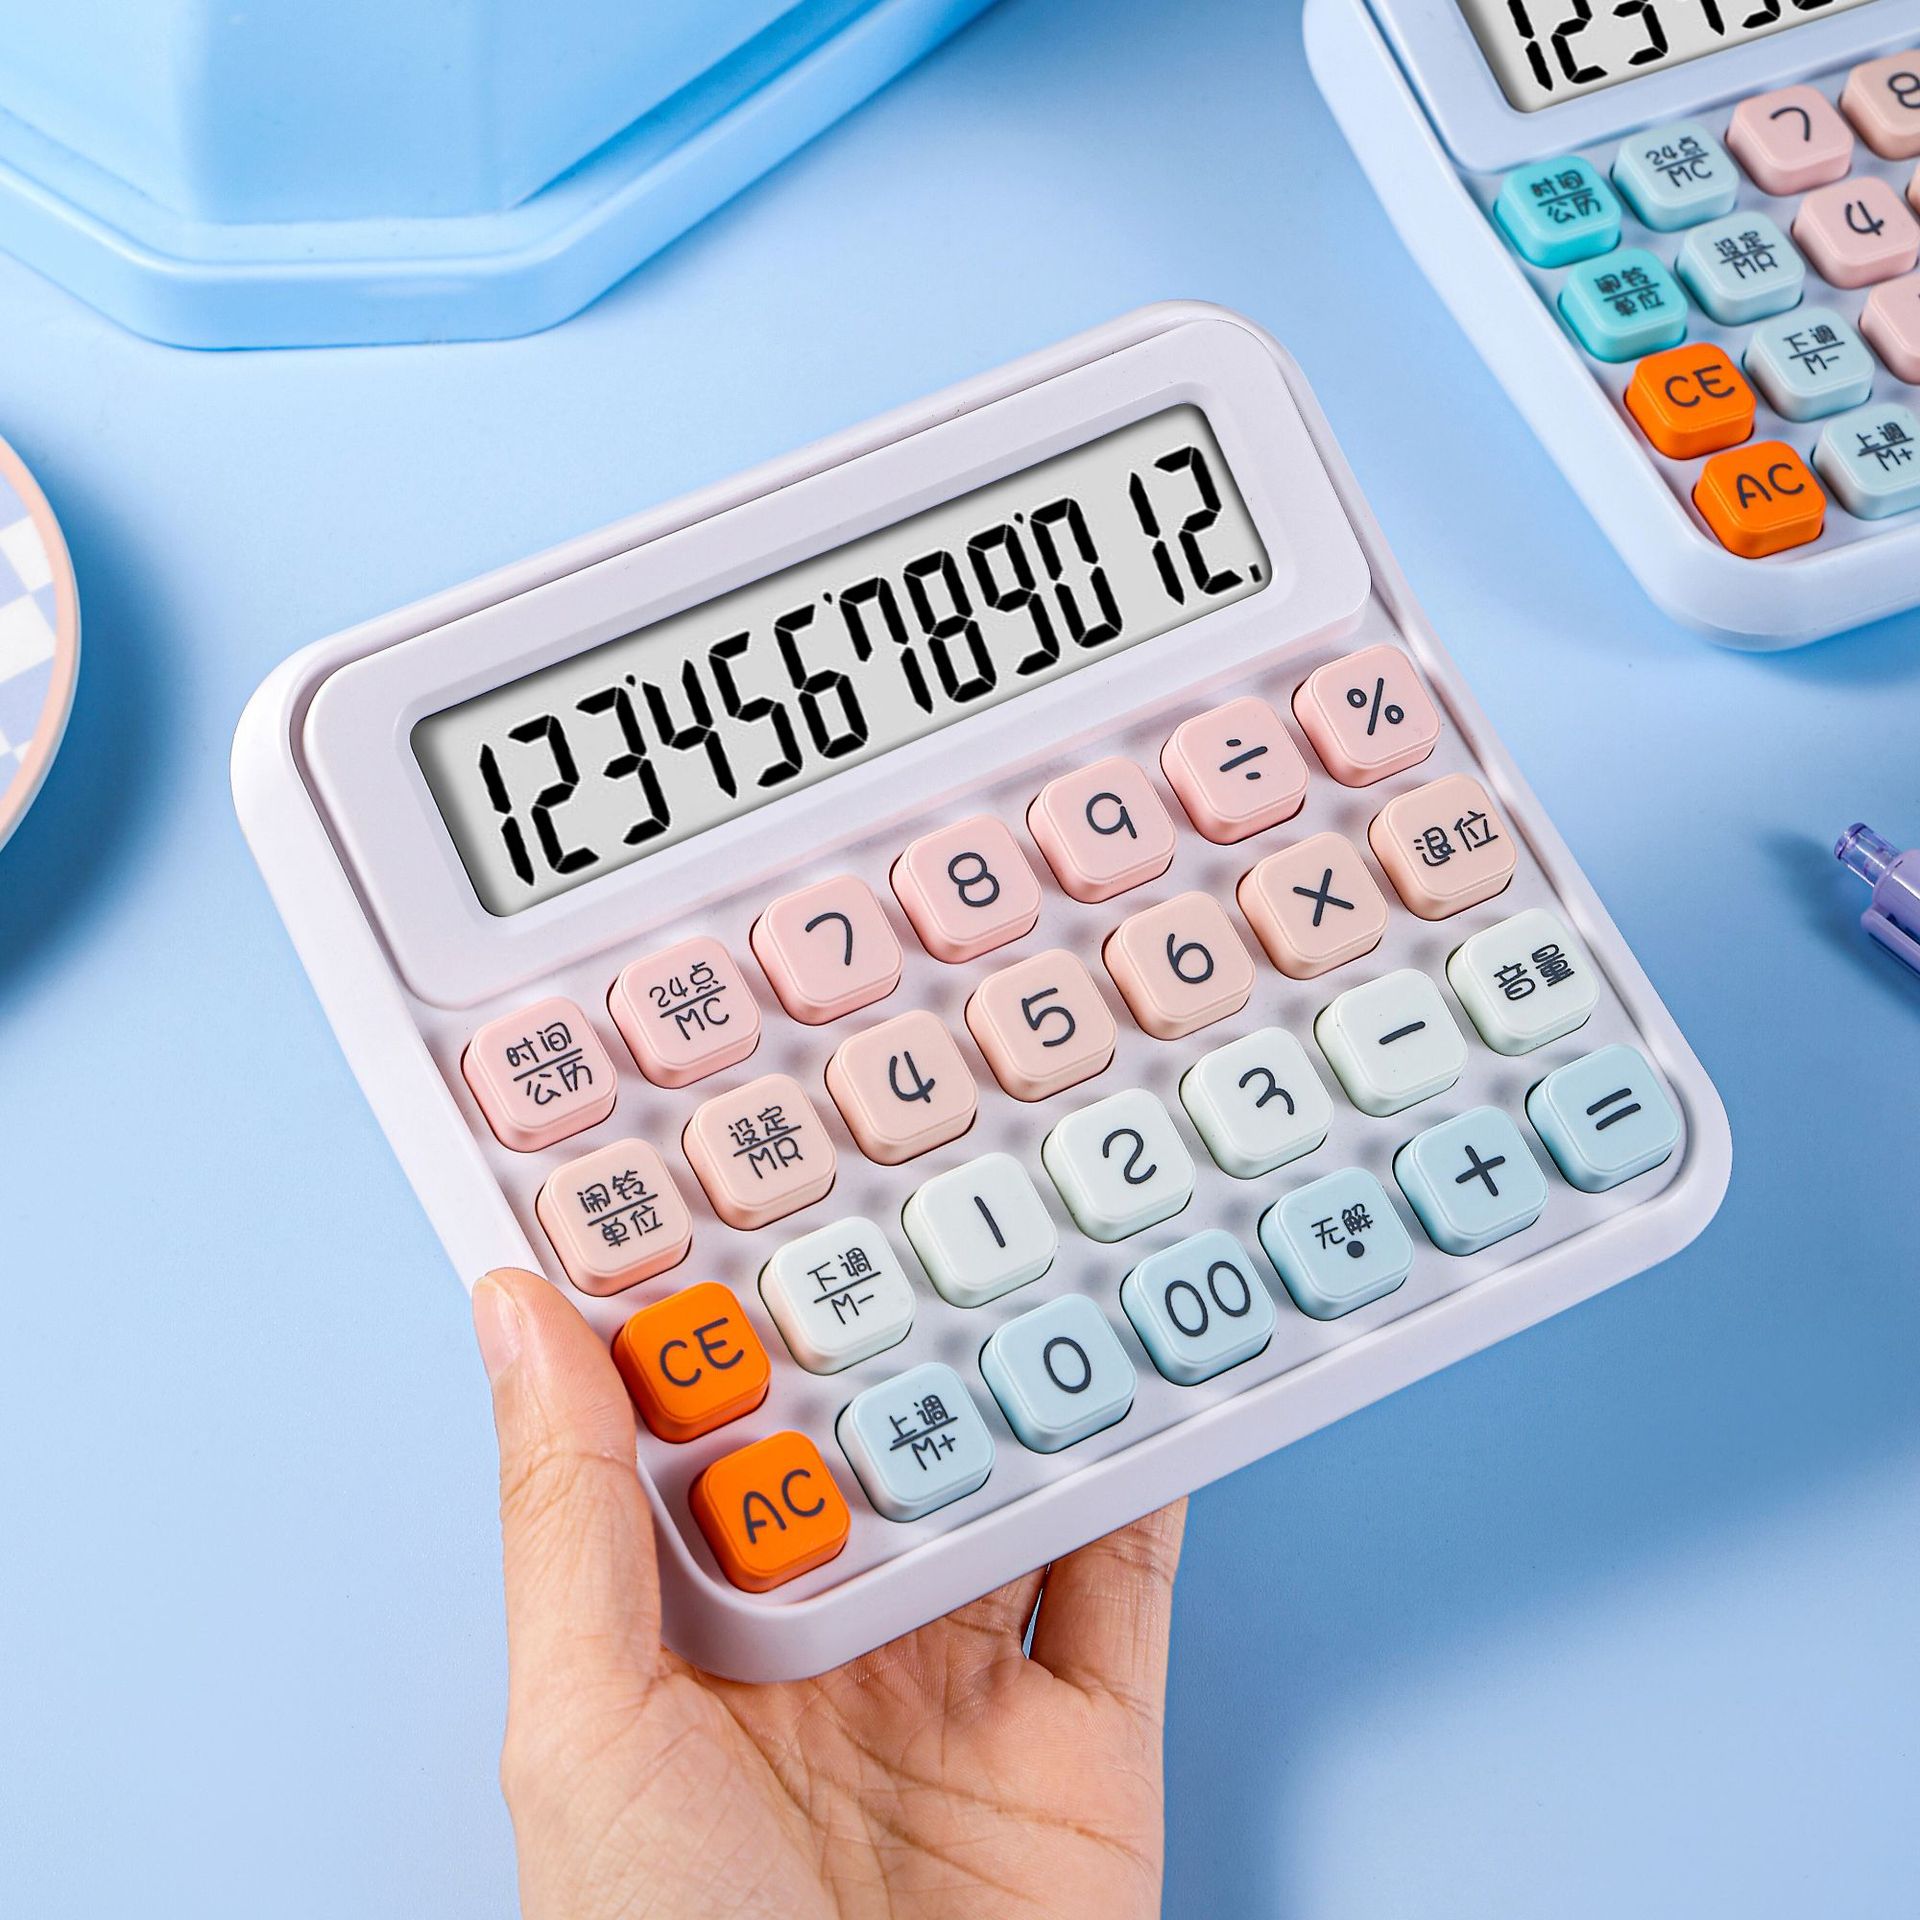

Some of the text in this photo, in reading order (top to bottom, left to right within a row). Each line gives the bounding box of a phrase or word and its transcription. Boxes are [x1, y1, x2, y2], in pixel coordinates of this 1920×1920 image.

[1770, 107, 1811, 142] 7
[1667, 160, 1712, 188] MC
[1845, 201, 1884, 236] 4
[1665, 365, 1735, 407] CE
[1737, 463, 1804, 508] AC
[1347, 678, 1404, 735] %
[1086, 793, 1137, 839] 9
[1414, 811, 1499, 866] 退位
[948, 852, 1000, 907] 8
[805, 912, 853, 966] 7
[1167, 933, 1214, 984] 6
[649, 962, 719, 1007] 24点
[1494, 944, 1574, 1001] 音量
[674, 997, 730, 1040] MC
[1021, 988, 1075, 1047] 5
[506, 1022, 572, 1067] 时间
[526, 1055, 592, 1105] 公历
[889, 1051, 935, 1103] 4
[1239, 1068, 1294, 1115] 3
[728, 1105, 789, 1145] 设定
[748, 1137, 803, 1179] MR
[1103, 1129, 1157, 1184] 2
[577, 1170, 647, 1213] 闹铃
[601, 1205, 663, 1247] 单位
[974, 1196, 1006, 1248] 1
[1311, 1204, 1373, 1247] 无解
[807, 1247, 872, 1291] 下调
[1165, 1261, 1251, 1337] 00
[660, 1318, 744, 1387] CE
[1043, 1337, 1091, 1394] 0
[888, 1394, 951, 1443] 上调
[910, 1433, 956, 1472] M+
[743, 1469, 825, 1544] AC
